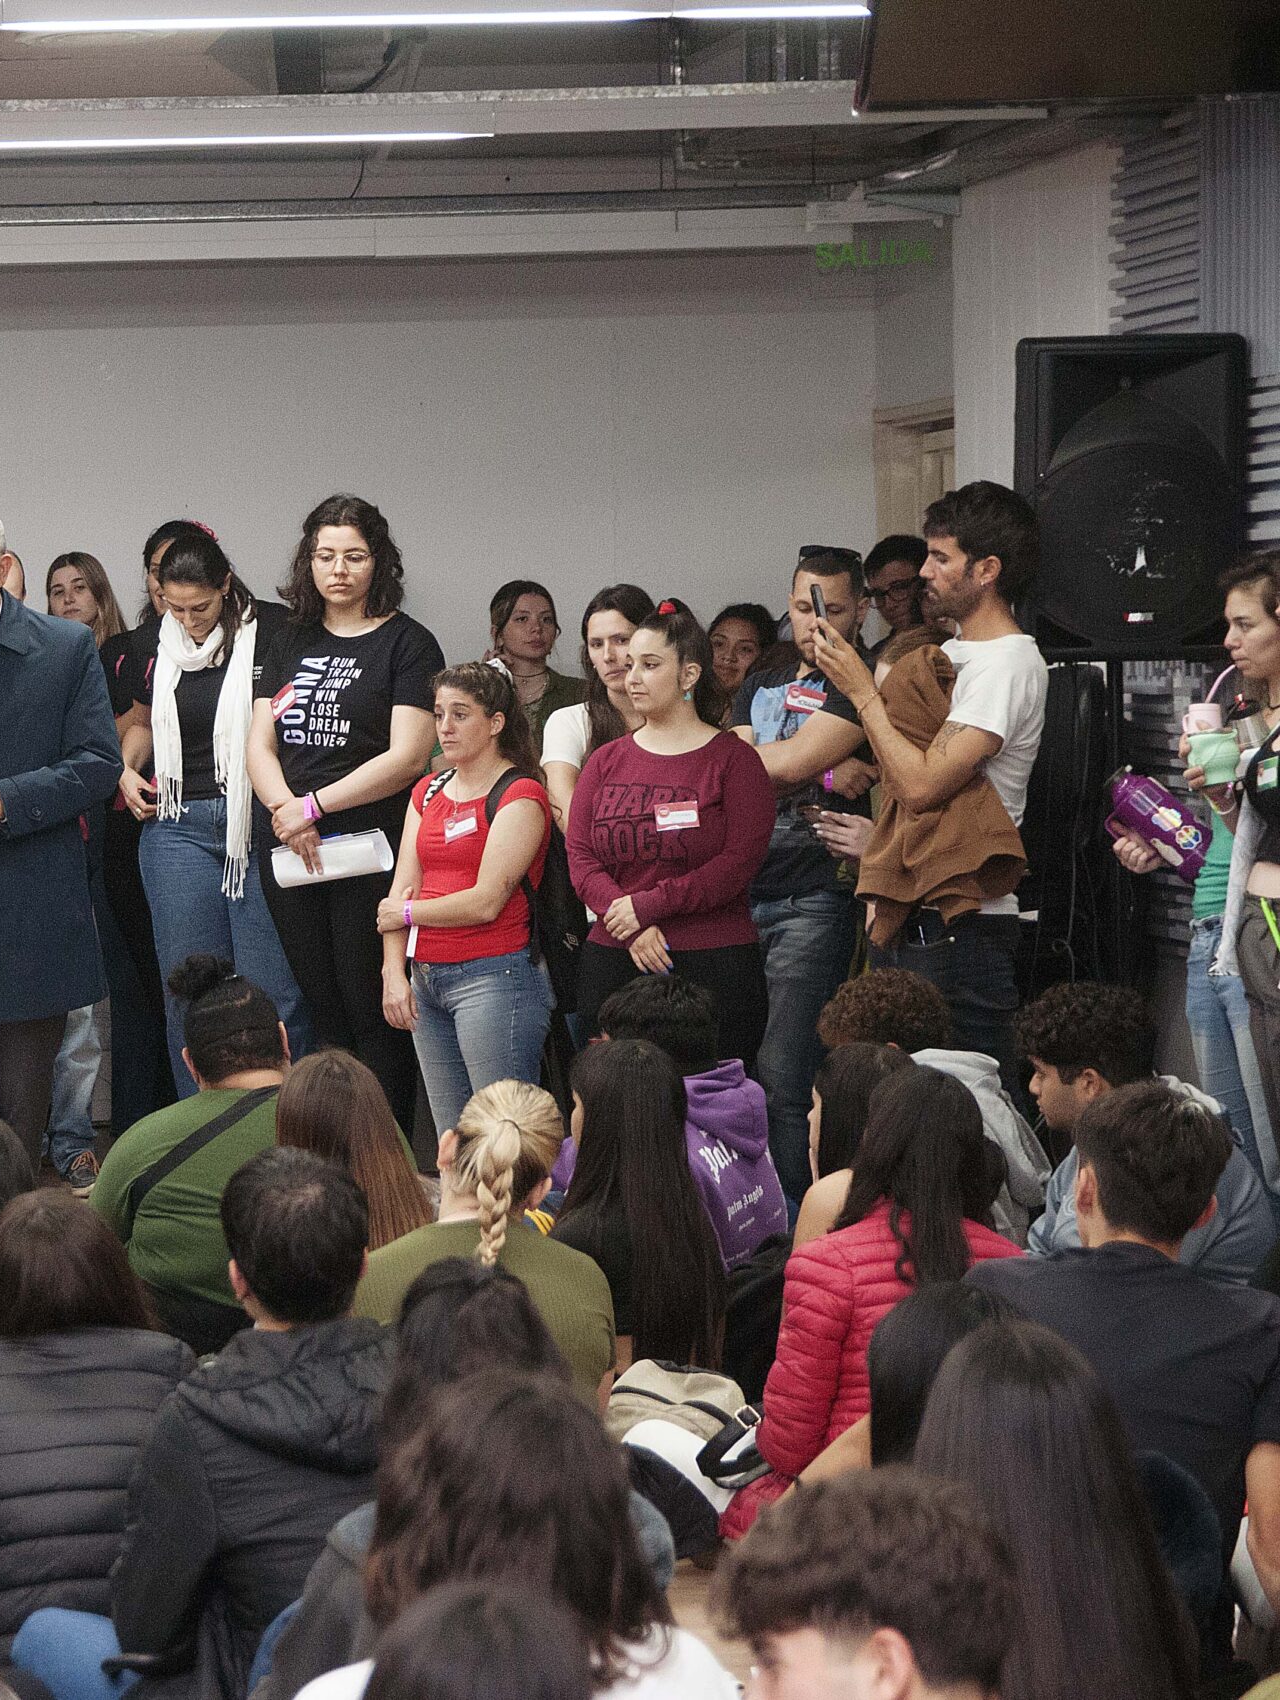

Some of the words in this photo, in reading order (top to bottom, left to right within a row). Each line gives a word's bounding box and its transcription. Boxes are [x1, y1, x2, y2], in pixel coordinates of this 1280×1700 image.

[331, 657, 357, 668] RUN
[327, 668, 362, 679] TRAIN
[319, 679, 351, 689] JUMP
[281, 656, 330, 744] GONNA
[315, 690, 338, 702] WIN
[310, 703, 341, 717] LOSE
[309, 717, 350, 733] DREAM
[307, 732, 336, 747] LOVE
